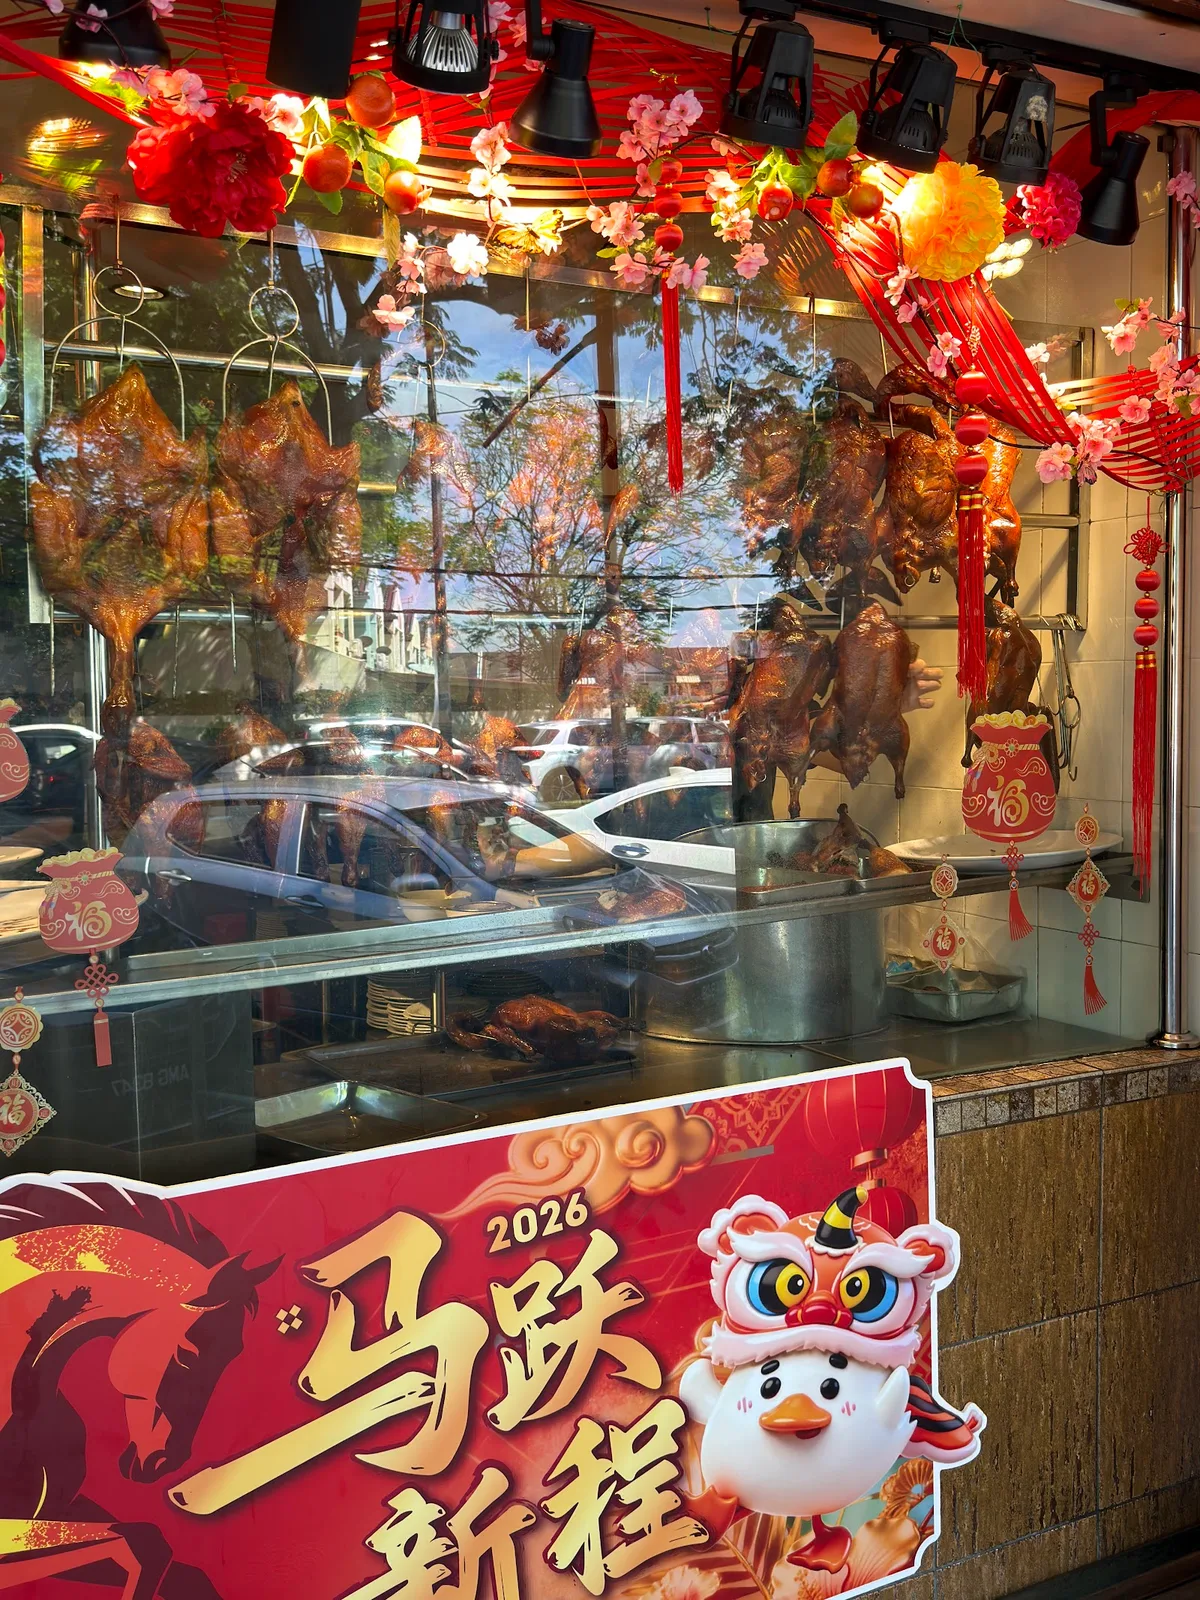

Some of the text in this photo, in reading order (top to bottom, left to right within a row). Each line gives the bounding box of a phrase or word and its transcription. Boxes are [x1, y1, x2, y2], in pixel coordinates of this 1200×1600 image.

[986, 775, 1030, 827] 福
[1081, 872, 1096, 896] 福
[65, 901, 112, 942] 福
[936, 927, 952, 951] 福
[0, 1094, 26, 1126] 福
[486, 1192, 588, 1254] 2026
[168, 1211, 662, 1515] 马跃
[340, 1399, 710, 1600] 新程
